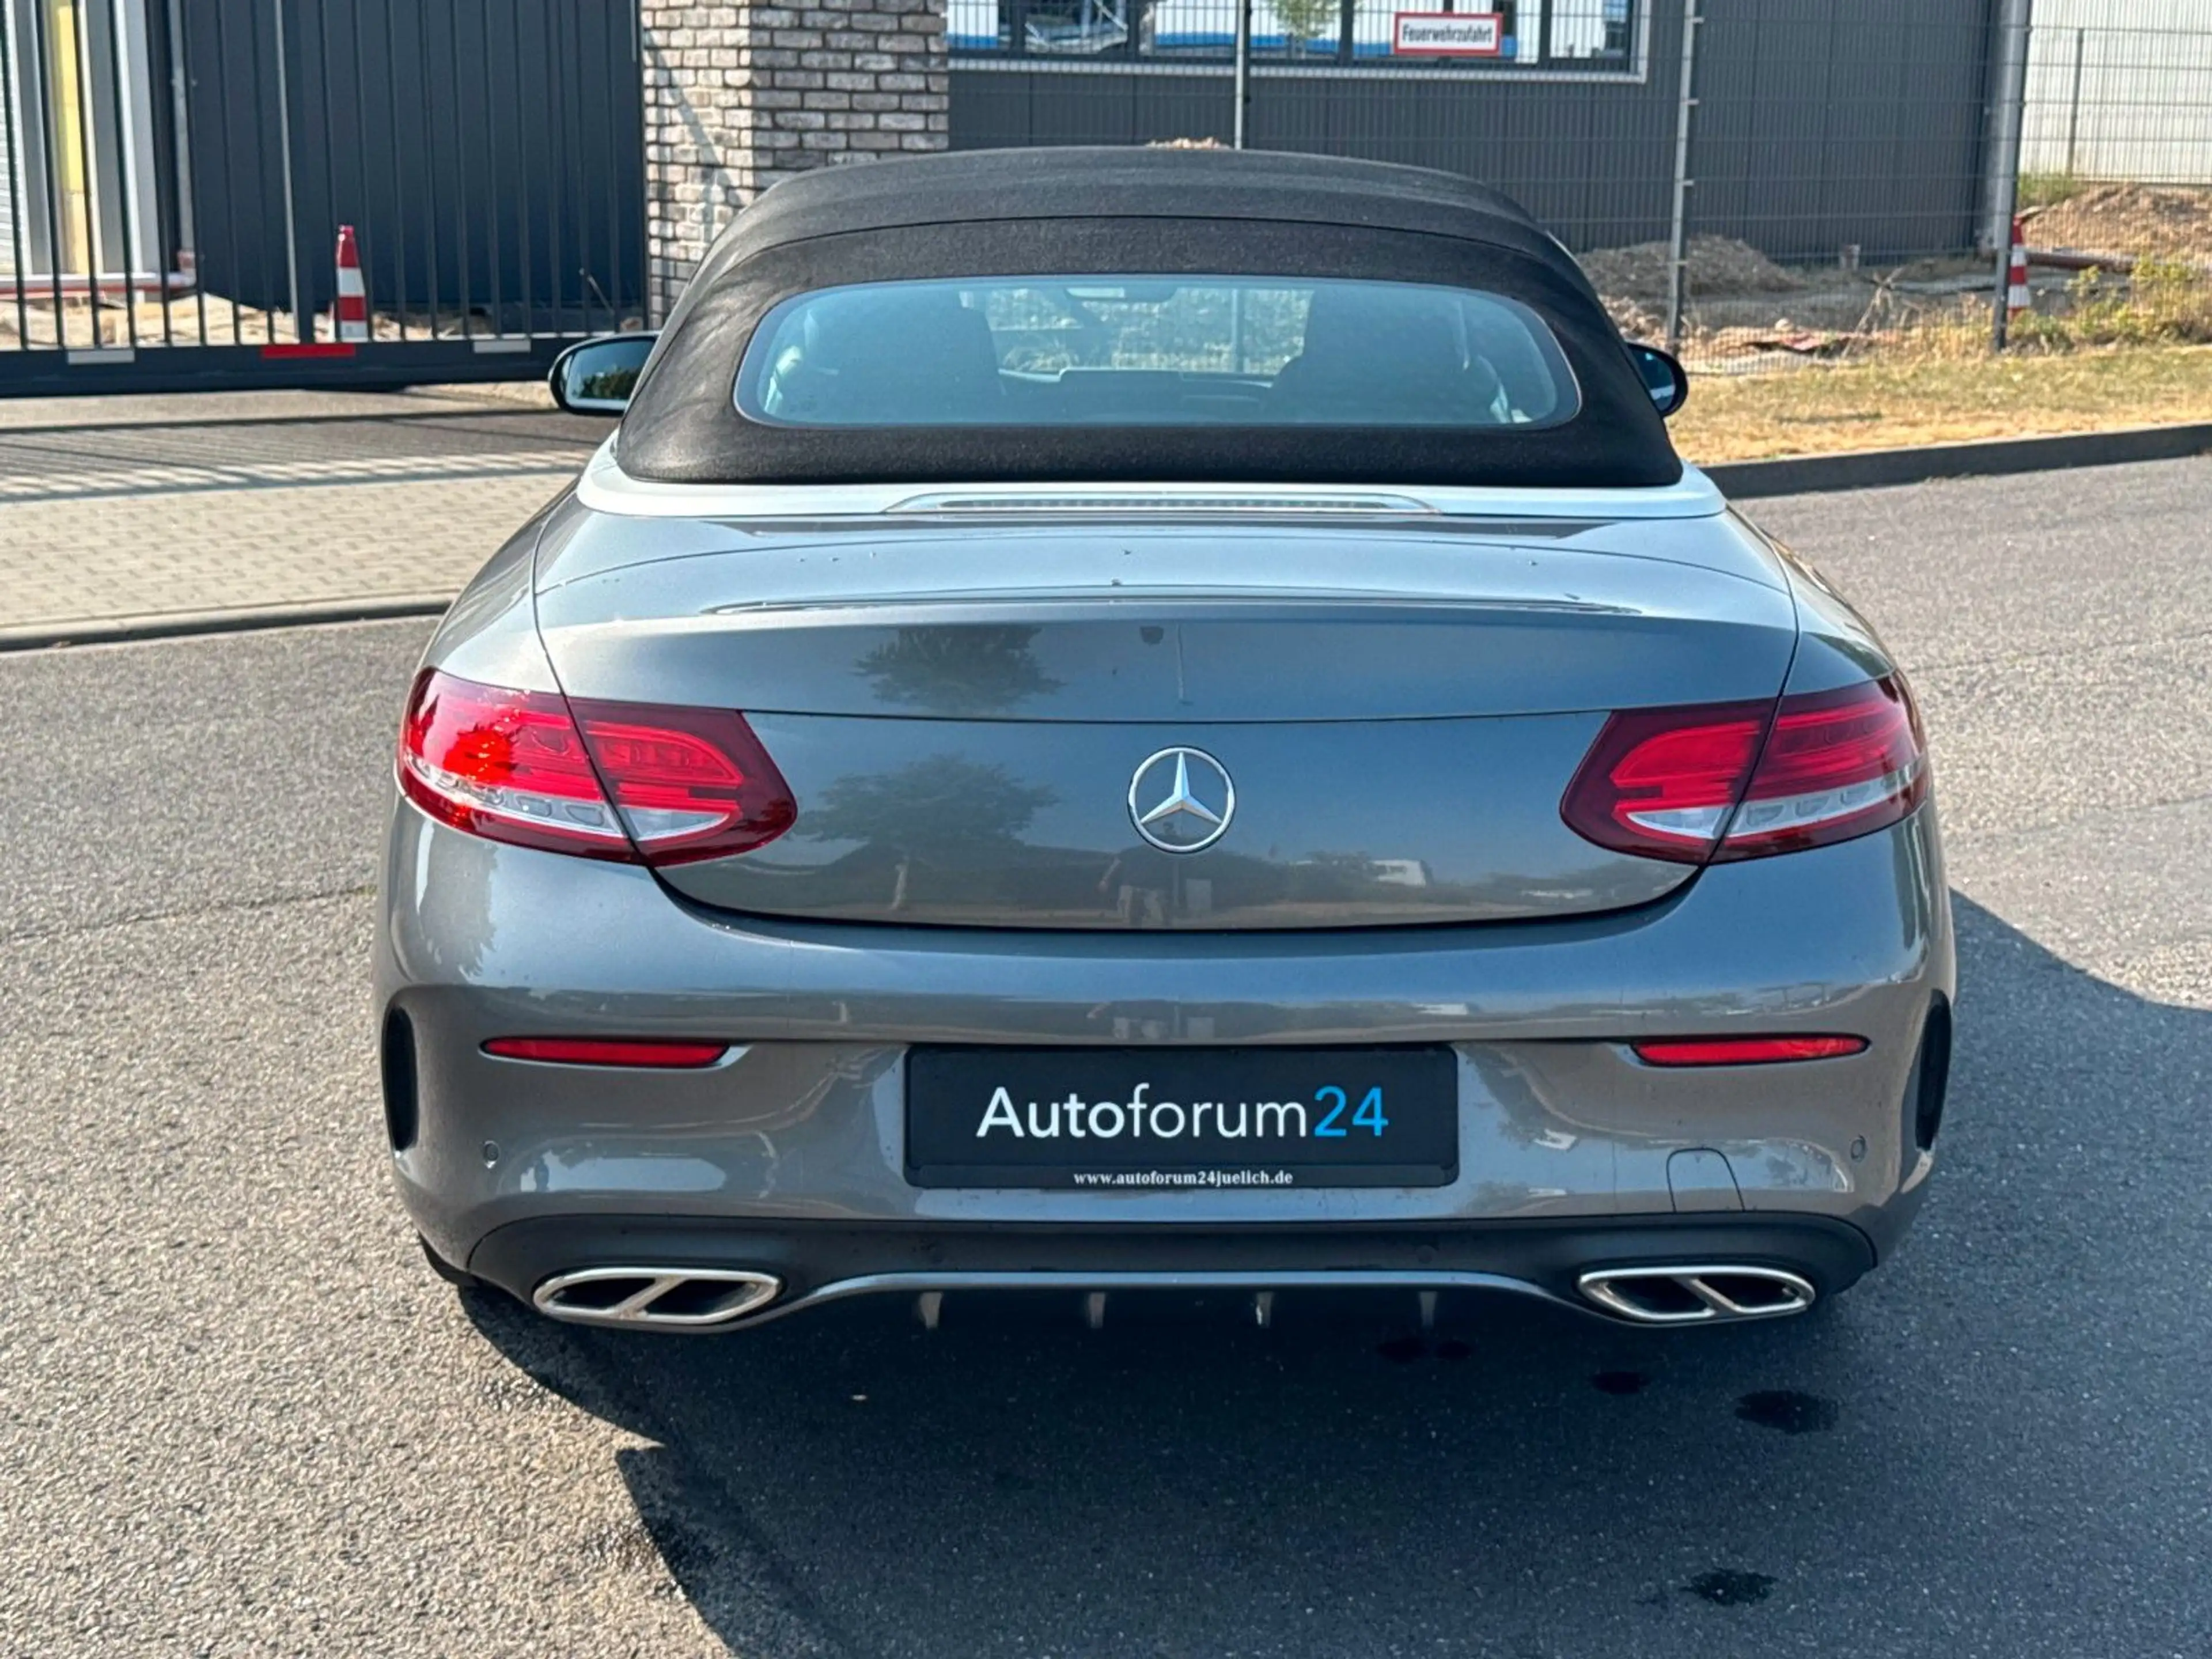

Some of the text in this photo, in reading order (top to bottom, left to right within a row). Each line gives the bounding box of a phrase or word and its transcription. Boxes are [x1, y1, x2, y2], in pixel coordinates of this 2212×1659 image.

[1402, 24, 1493, 43] Feuerwehrzufahrt
[976, 1082, 1388, 1138] Autoforum24
[1073, 1170, 1293, 1186] www.autoforum24juelich.de
